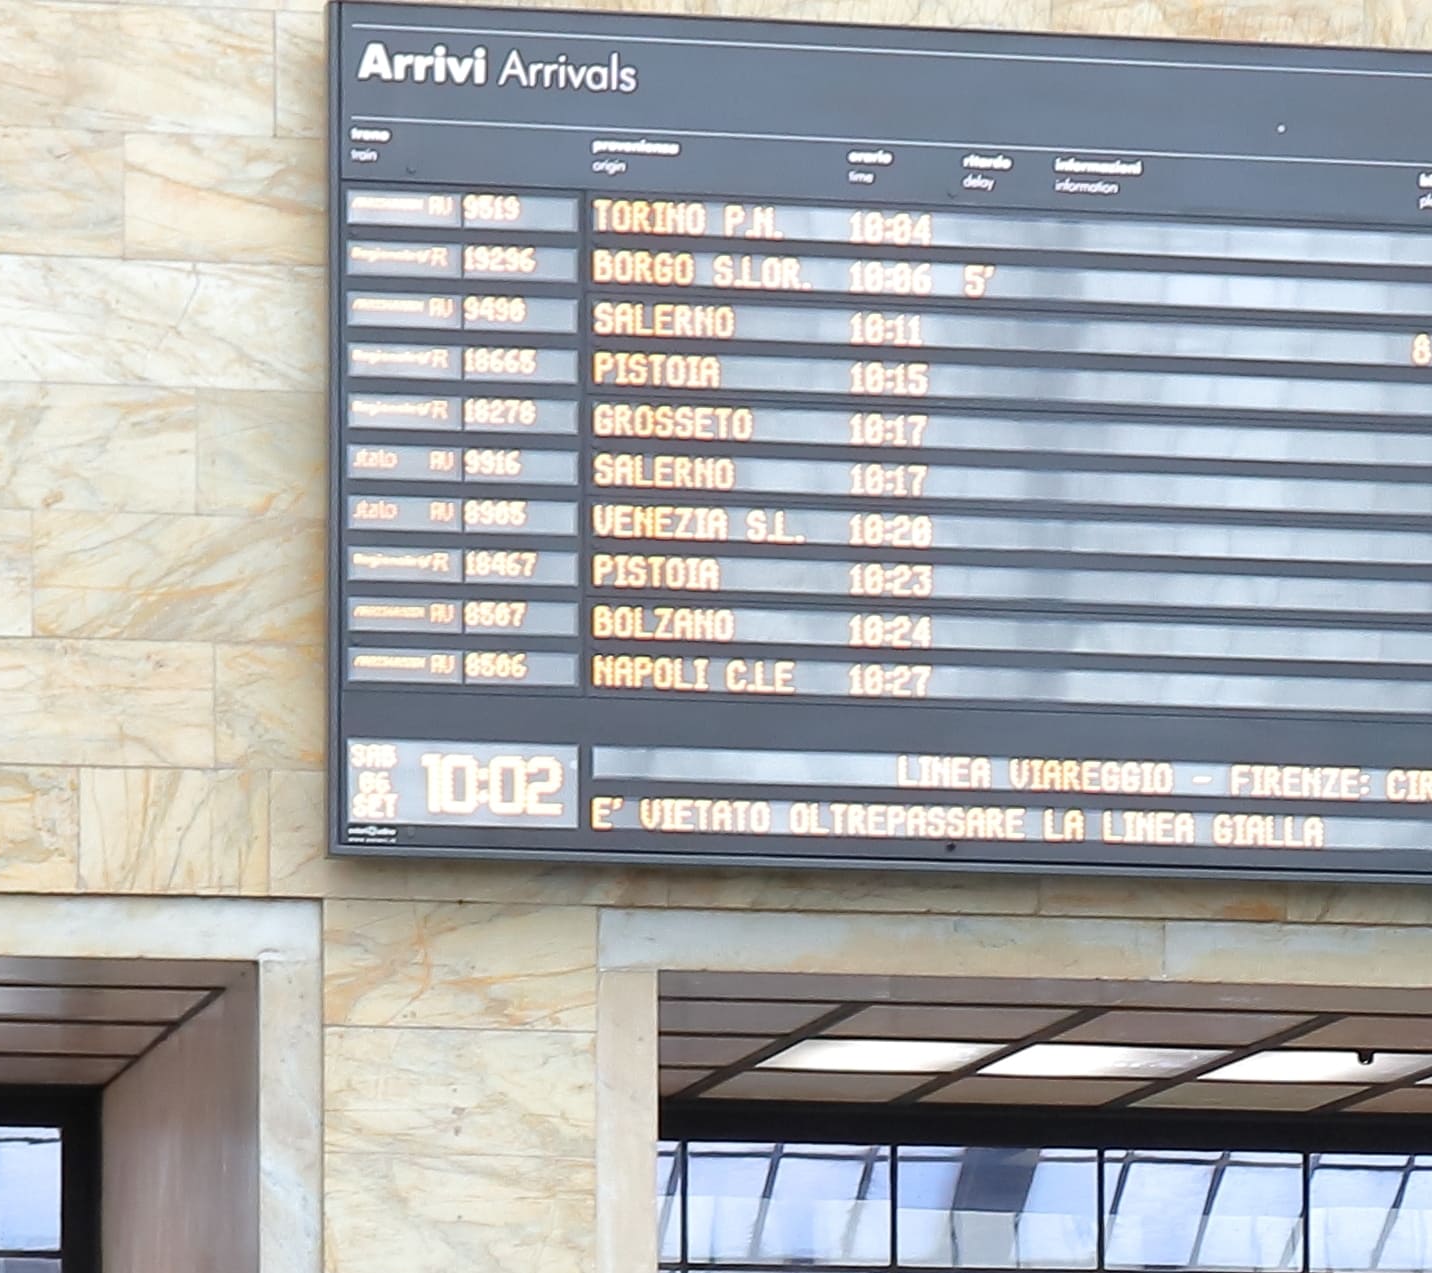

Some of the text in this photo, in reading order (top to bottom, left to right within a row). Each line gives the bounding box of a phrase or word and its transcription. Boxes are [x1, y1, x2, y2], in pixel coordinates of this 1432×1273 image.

[358, 43, 638, 94] Arrivi Arrivals
[593, 199, 706, 235] TORINO
[849, 211, 932, 246] 10:04
[593, 250, 694, 285] BORGO
[849, 261, 932, 295] 10:06
[593, 303, 923, 346] SALERNO 10:11
[593, 352, 720, 388] PISTOIA
[849, 362, 929, 395] 10:15
[593, 404, 753, 440] GROSSETO
[849, 414, 928, 447] 10:17
[593, 453, 734, 489] SALERNO
[849, 464, 928, 496] 10:17
[593, 505, 728, 541] VENEZIA
[849, 514, 933, 547] 10:20
[593, 555, 720, 591] PISTOIA
[849, 564, 933, 597] 10:23
[593, 606, 932, 648] BOLZANO 10:24
[593, 655, 710, 690] NAPOLI
[849, 664, 932, 697] 10:27
[421, 753, 564, 816] 10:02
[896, 755, 992, 789] LINEA
[1009, 758, 1173, 795] VIAREGGIO
[1230, 765, 1370, 800] FIRENZE:
[639, 799, 1323, 848] VIETATO OLTREPASSARE LA LINEA GIALLA
